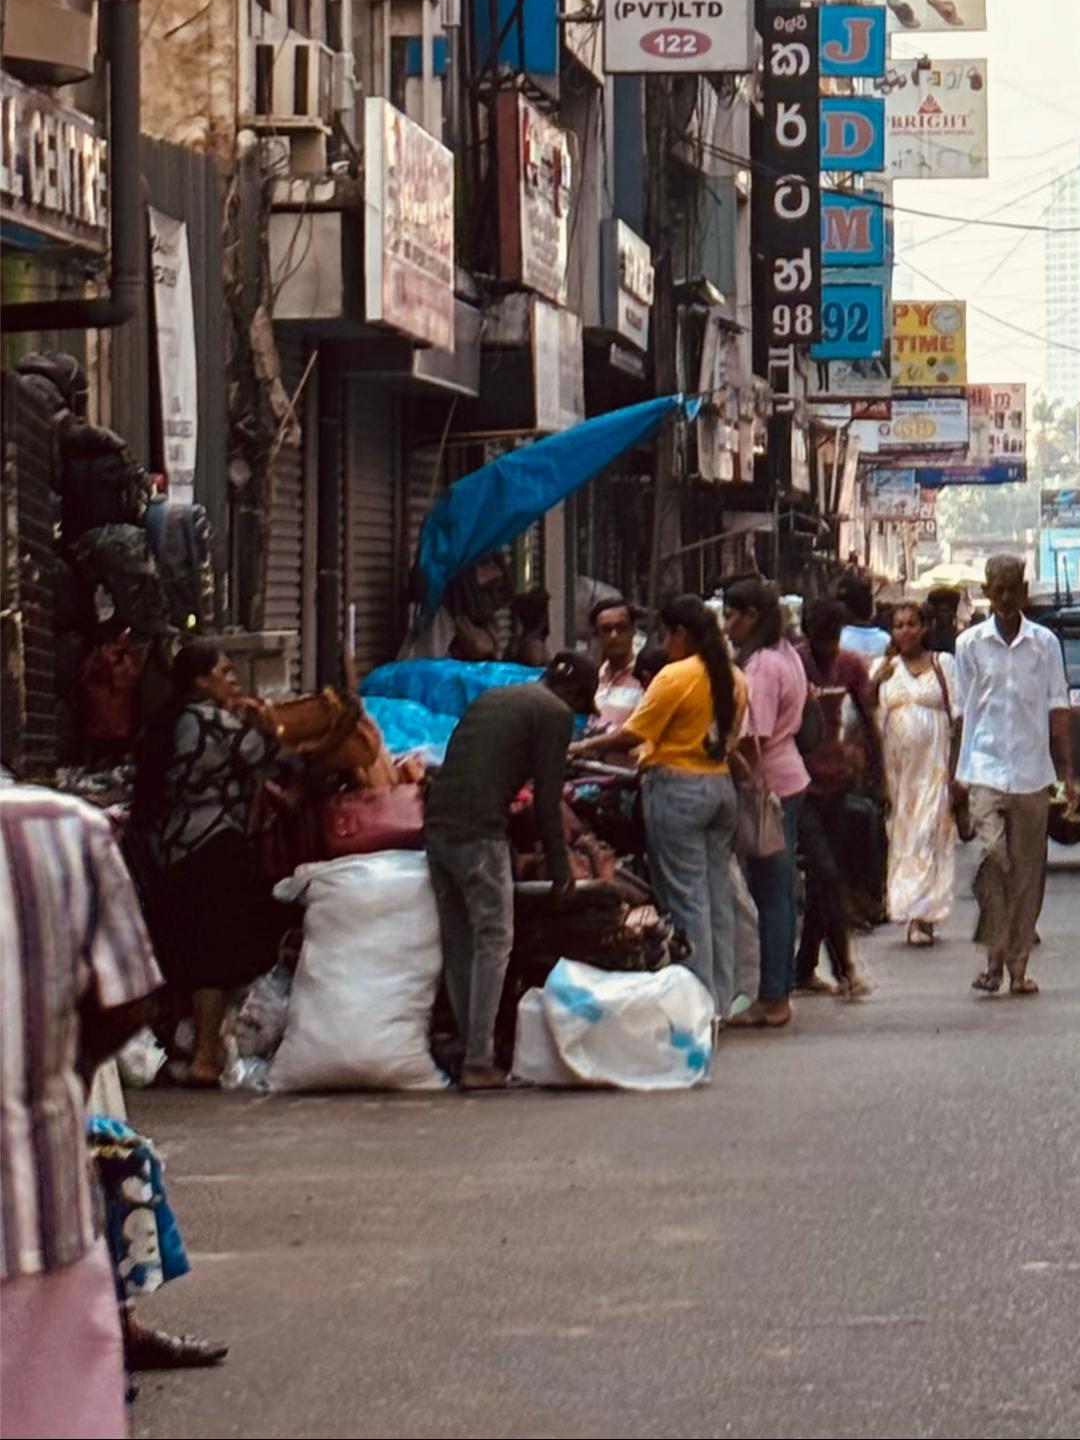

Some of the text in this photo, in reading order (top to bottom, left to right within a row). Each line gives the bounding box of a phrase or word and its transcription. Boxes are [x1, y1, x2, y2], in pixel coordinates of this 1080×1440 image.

[653, 33, 698, 54] 122
[891, 114, 969, 129] BRIGHT
[772, 304, 813, 336] 98
[822, 301, 870, 344] 92
[893, 335, 956, 353] TIME
